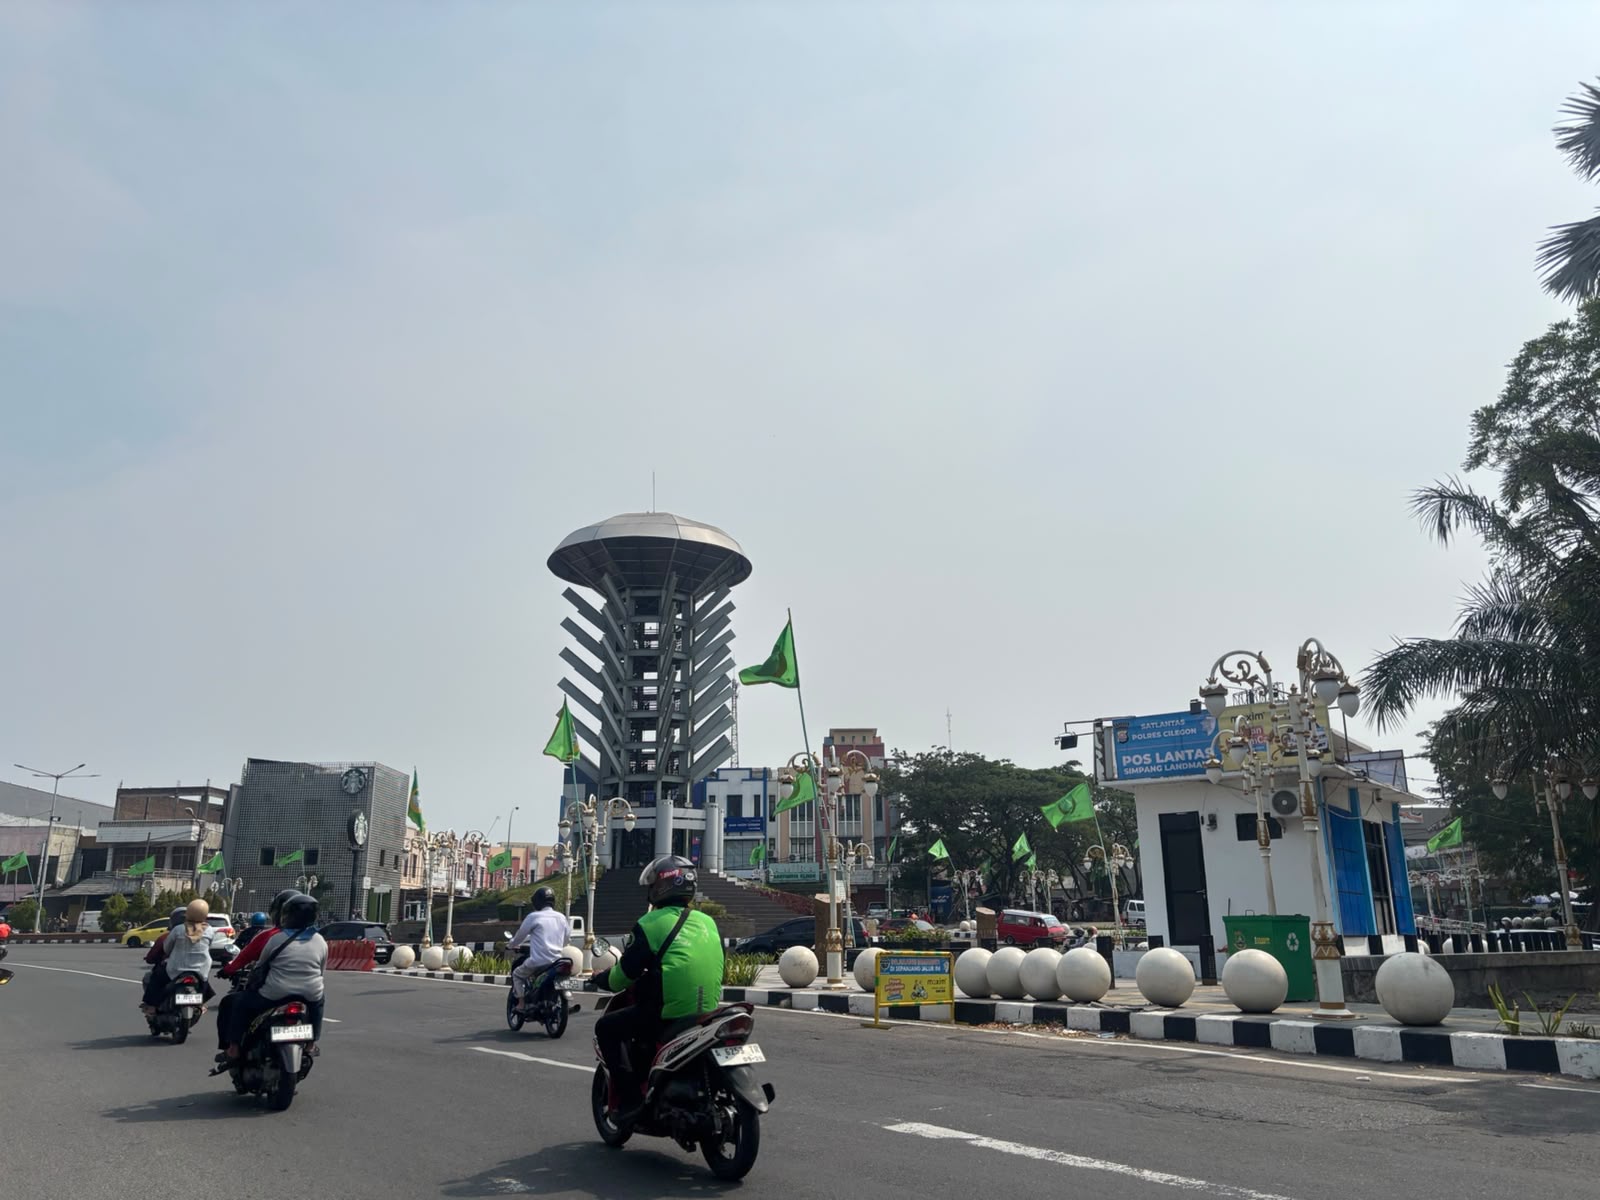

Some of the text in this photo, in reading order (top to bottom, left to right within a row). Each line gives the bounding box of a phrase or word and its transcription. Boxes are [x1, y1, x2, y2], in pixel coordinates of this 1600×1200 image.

[1141, 719, 1185, 730] SATLANTAS
[1132, 728, 1197, 741] POLRES CILEGON
[1122, 747, 1213, 767] POS LANTAS
[1123, 764, 1162, 775] SIMPANG
